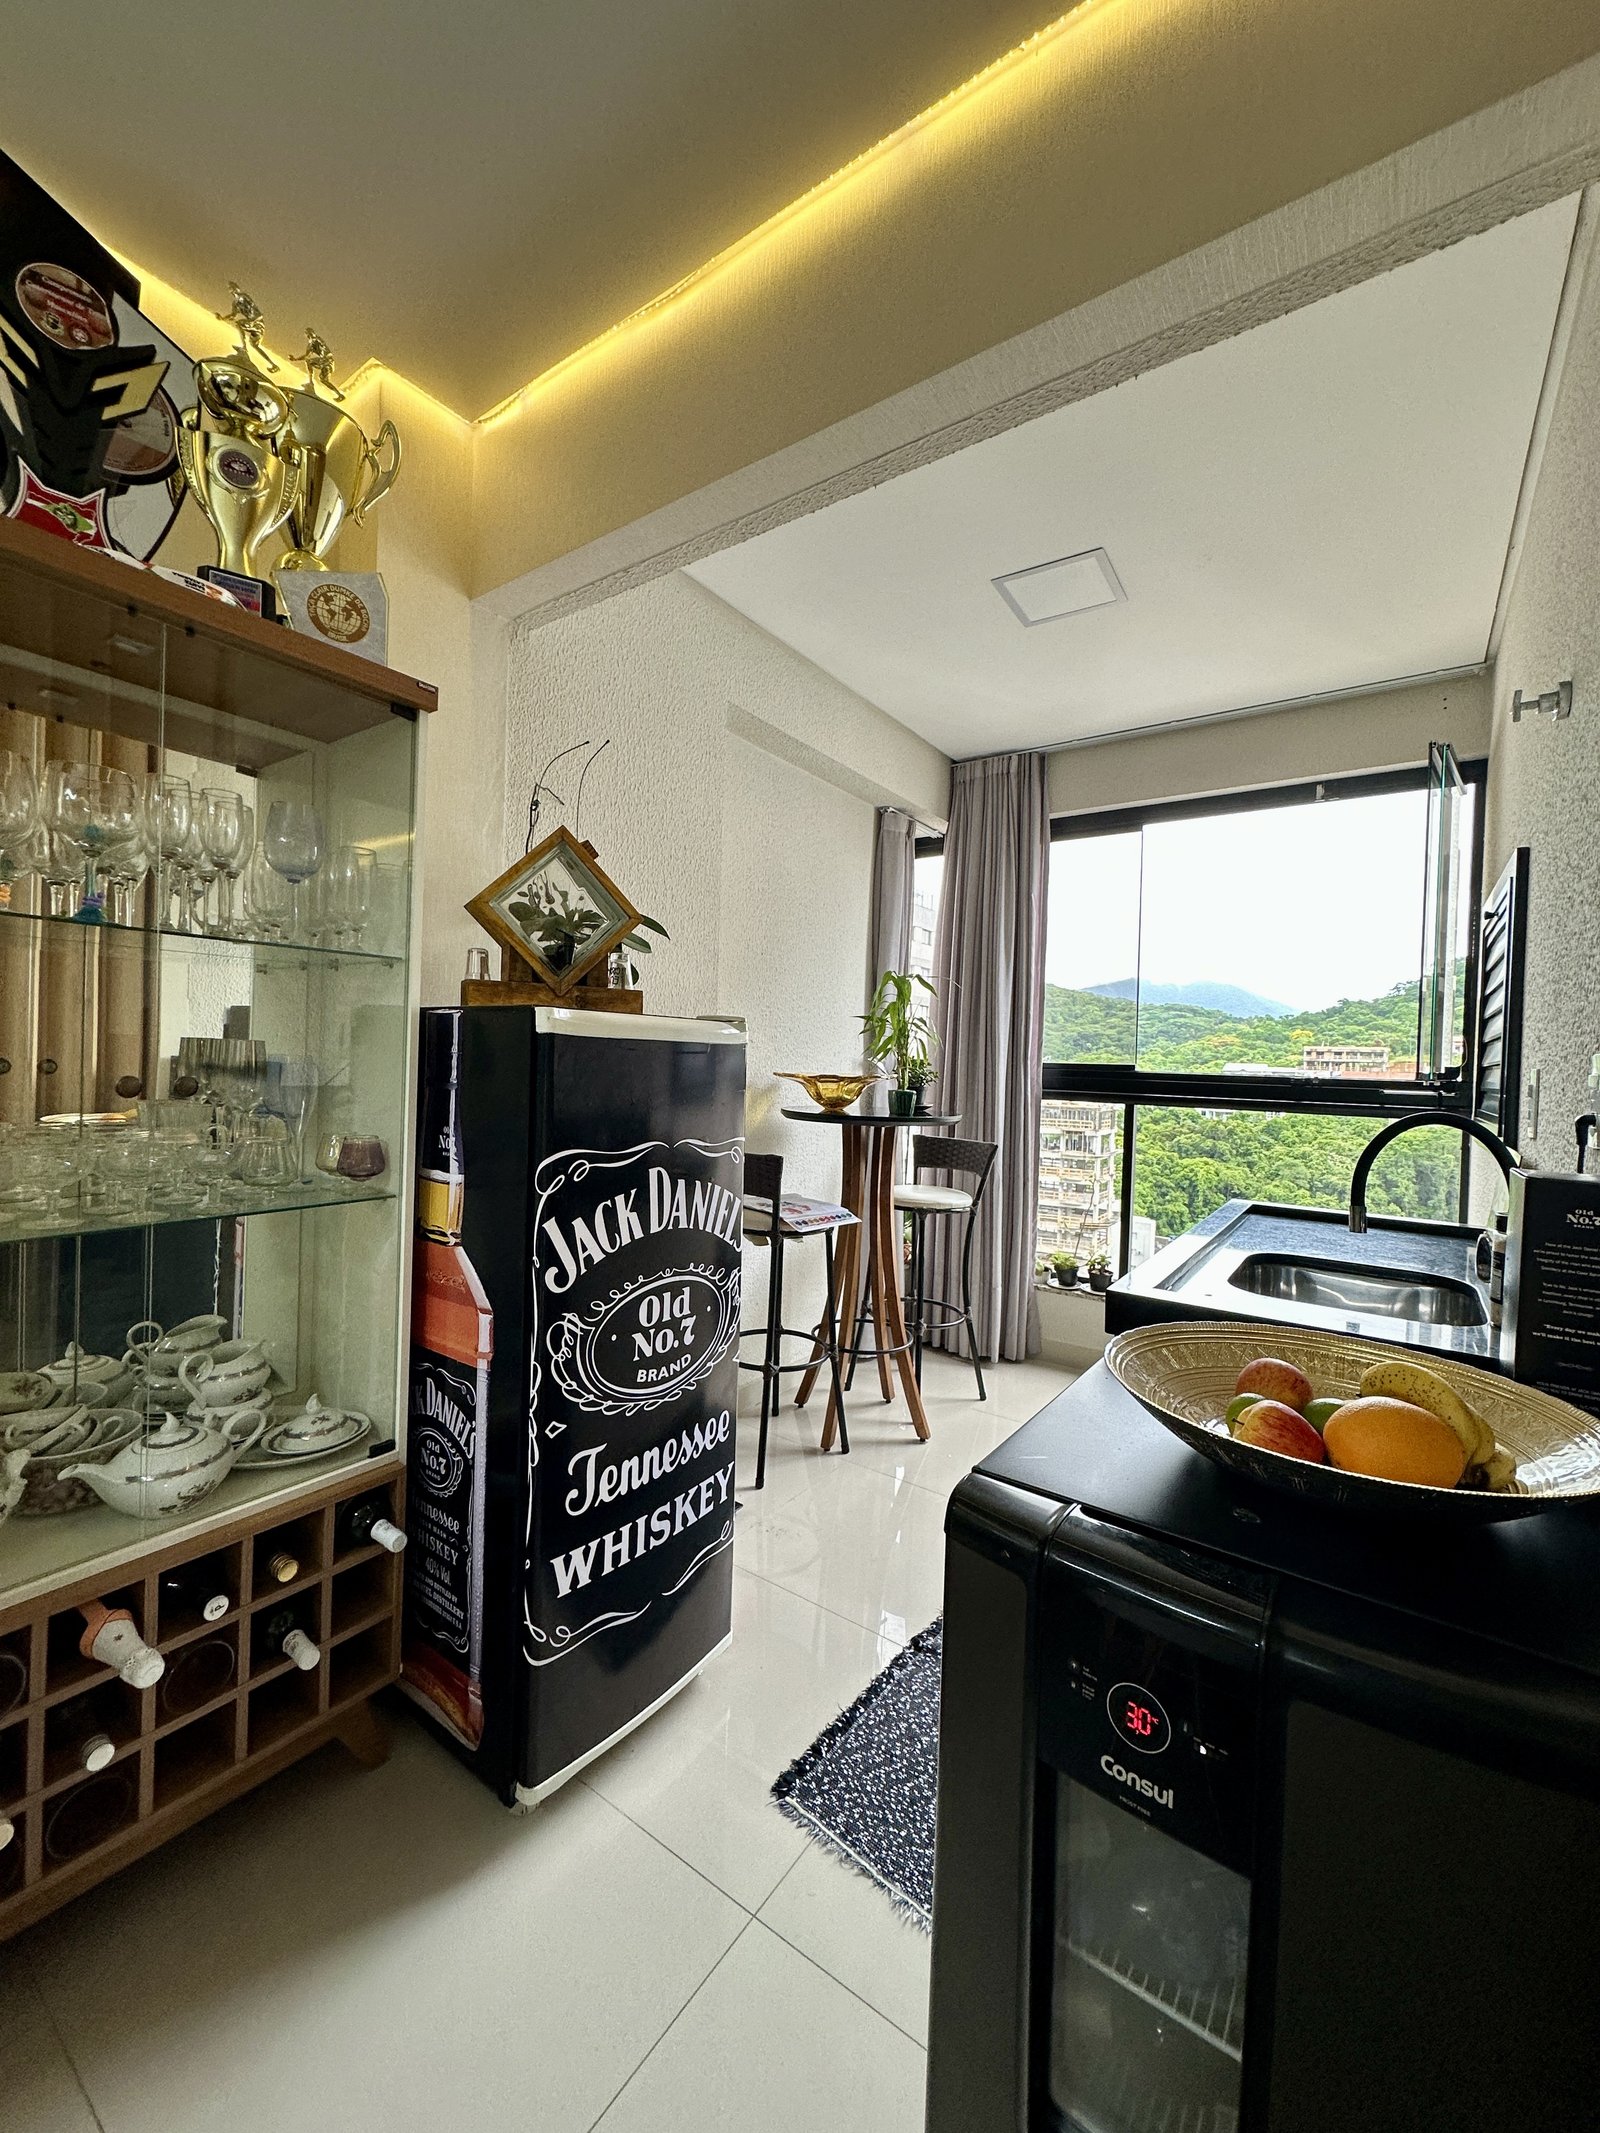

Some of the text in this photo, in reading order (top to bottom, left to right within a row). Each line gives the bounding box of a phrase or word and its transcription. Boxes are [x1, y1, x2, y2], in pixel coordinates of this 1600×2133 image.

[542, 1167, 743, 1294] JACK DANIEL
[638, 1286, 692, 1328] Old
[631, 1315, 697, 1361] No.7
[636, 1353, 692, 1383] BRAND
[420, 1447, 447, 1475] No.7
[426, 1439, 441, 1454] Old
[565, 1409, 730, 1517] Tennessee
[417, 1527, 459, 1566] HISKEY
[550, 1460, 735, 1599] WHISKEY
[1100, 1754, 1175, 1810] Consul
